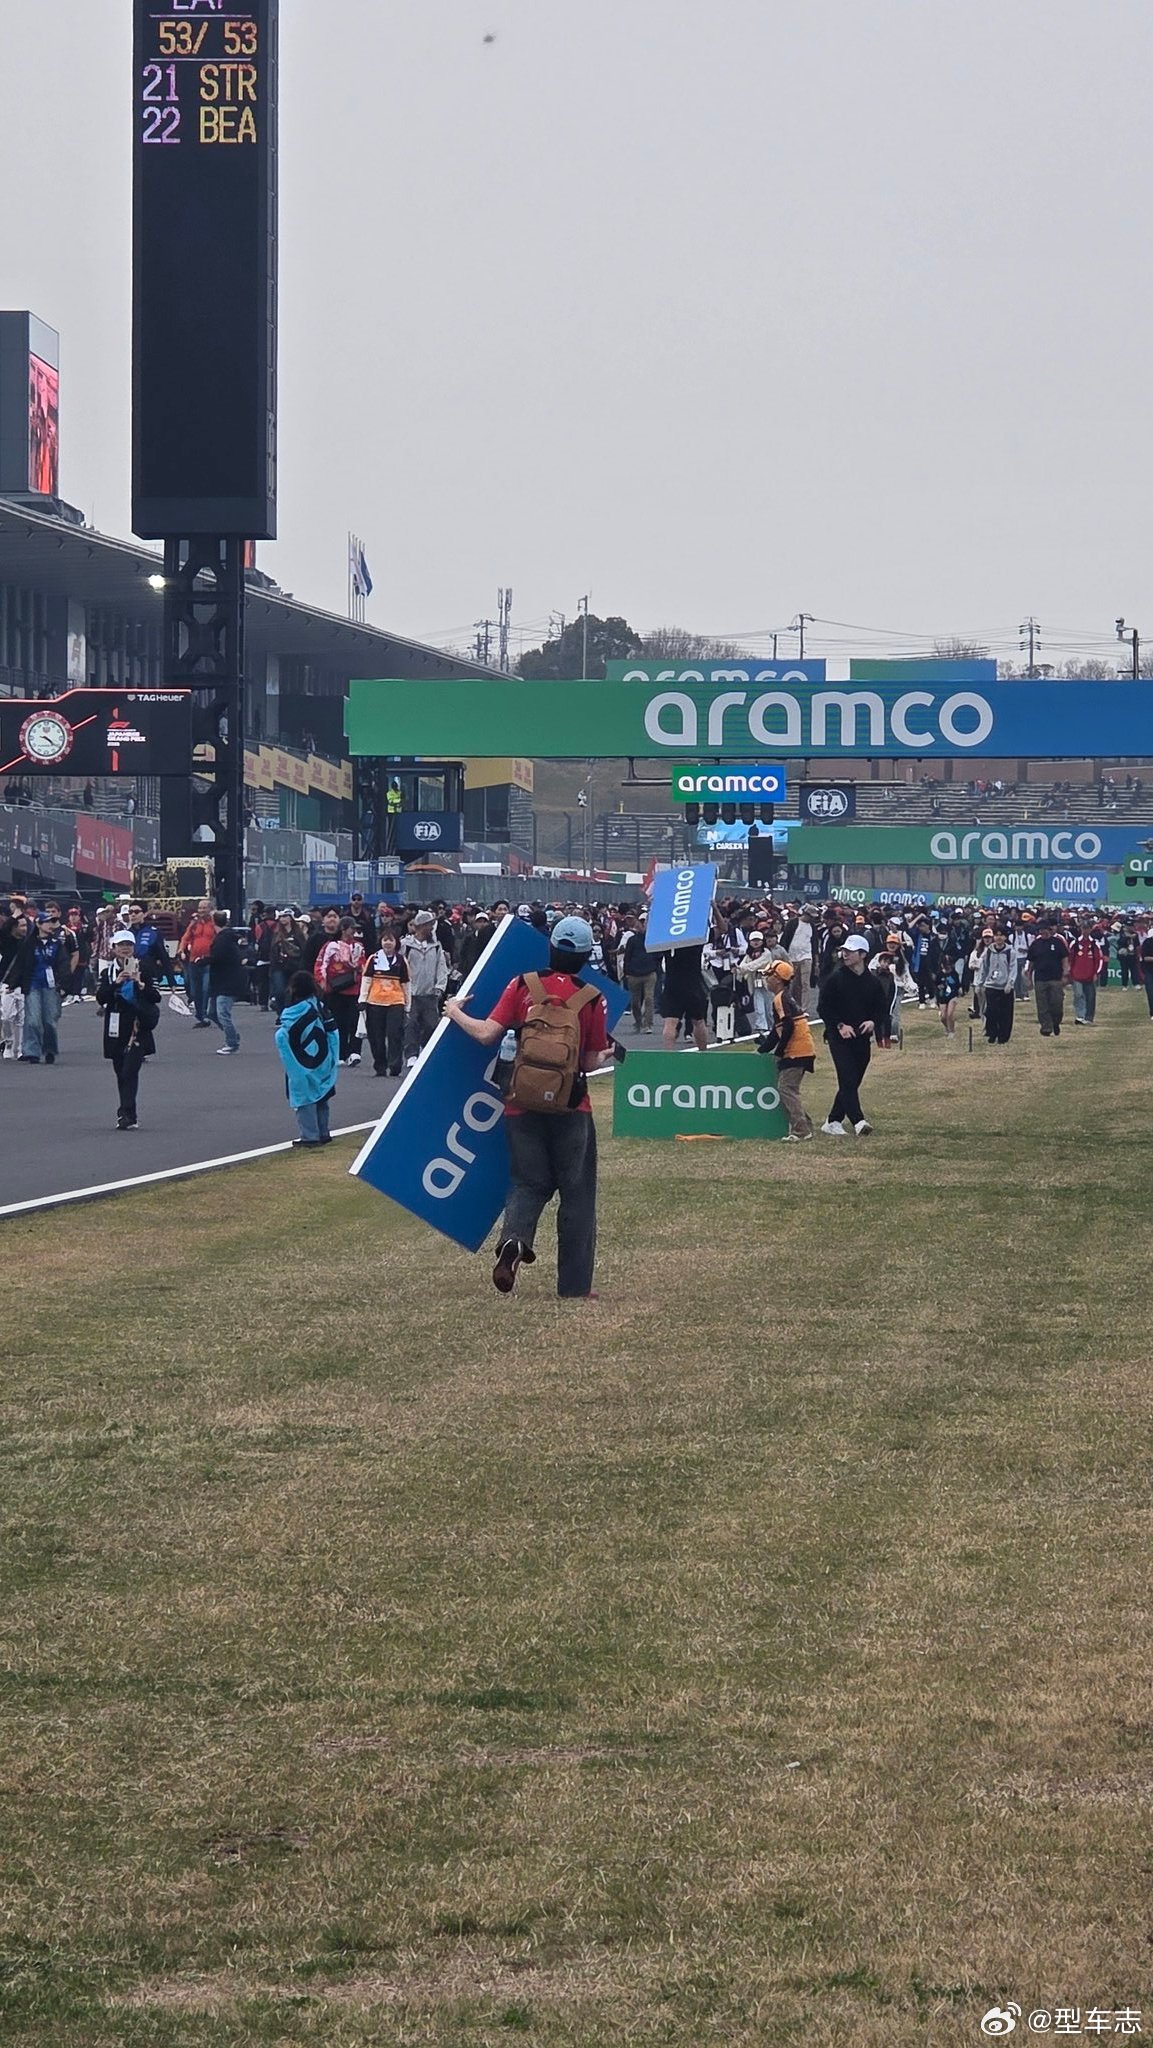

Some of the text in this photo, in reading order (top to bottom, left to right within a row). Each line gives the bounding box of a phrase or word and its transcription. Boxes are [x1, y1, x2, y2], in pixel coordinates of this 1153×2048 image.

[224, 22, 258, 54] 53
[142, 64, 257, 101] 21 STR
[142, 106, 257, 143] 22 BEA
[644, 691, 994, 747] aramco
[678, 775, 779, 792] aramco
[415, 824, 439, 837] FIA
[930, 831, 1102, 860] aramco
[985, 873, 1036, 890] aramco
[1052, 876, 1099, 893] aramco
[669, 870, 695, 936] aramco
[288, 1005, 328, 1069] 6
[627, 1083, 781, 1110] aramco
[422, 1056, 506, 1199] ara
